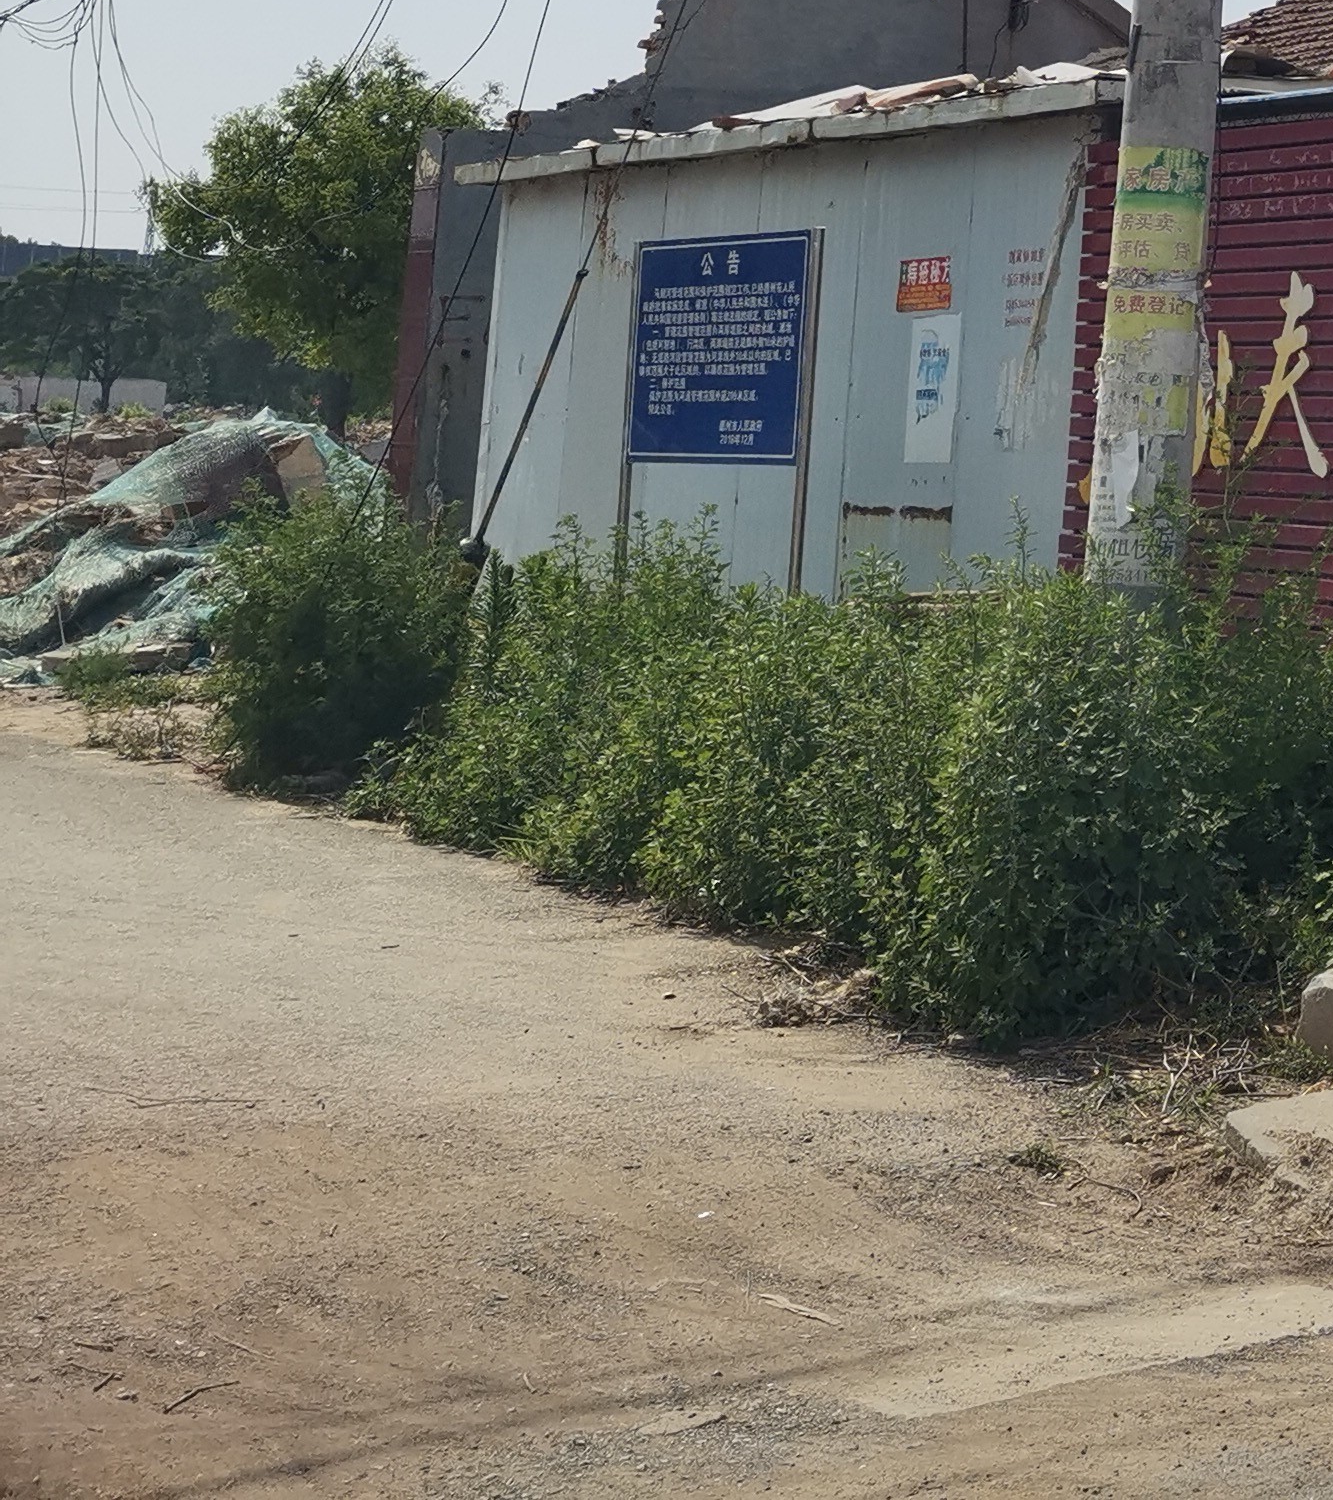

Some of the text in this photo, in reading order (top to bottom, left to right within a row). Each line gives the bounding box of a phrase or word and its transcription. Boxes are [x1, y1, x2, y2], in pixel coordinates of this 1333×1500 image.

[701, 250, 741, 276] 公告
[1112, 295, 1185, 315] 免费登记
